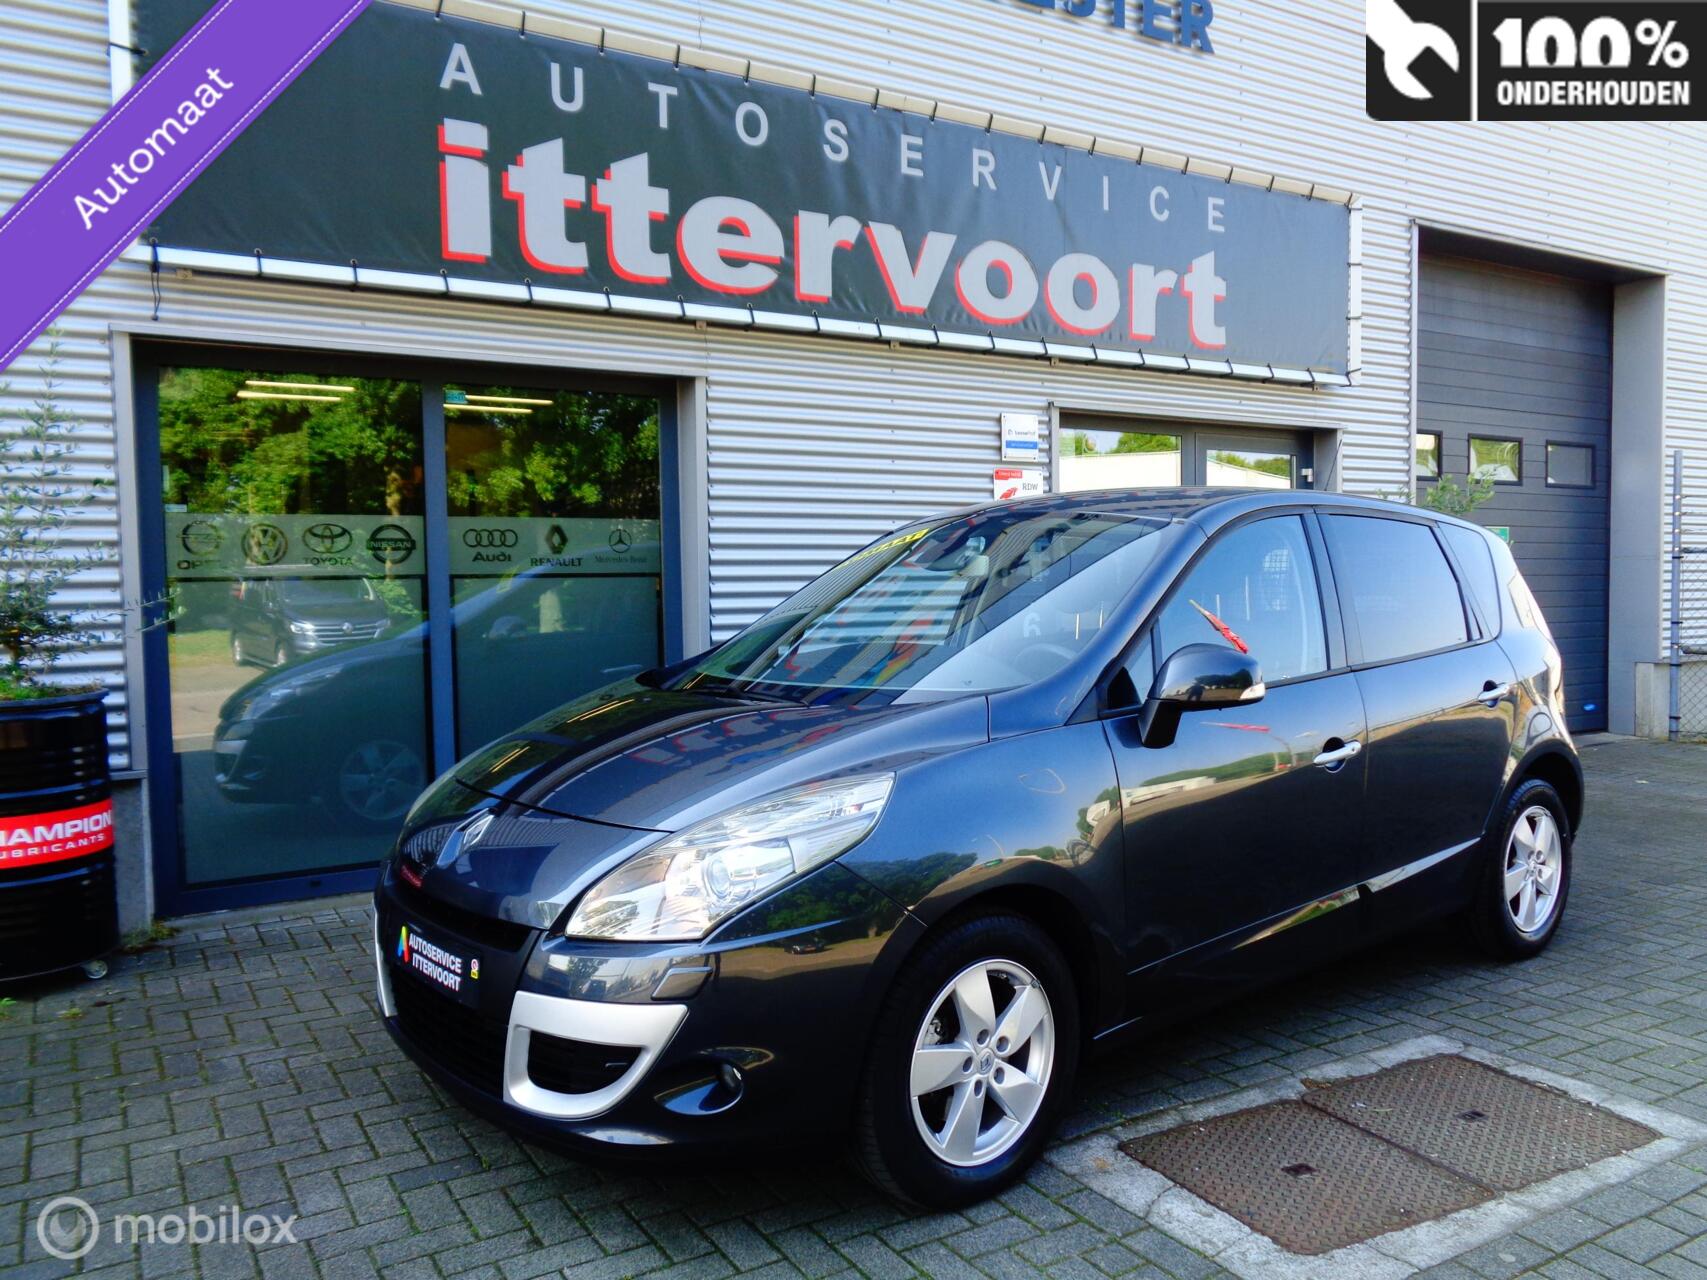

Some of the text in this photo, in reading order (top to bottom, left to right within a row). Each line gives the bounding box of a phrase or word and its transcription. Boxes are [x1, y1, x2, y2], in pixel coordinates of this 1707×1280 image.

[437, 117, 1227, 349] ittervoort
[1022, 483, 1038, 491] RDW
[370, 540, 411, 548] NISSAN
[304, 557, 353, 566] TOYOTA
[531, 557, 583, 567] RENAULT
[0, 810, 112, 847] AMPION
[409, 933, 462, 974] AUTOSERVICE
[412, 953, 461, 991] ITTERVOORT
